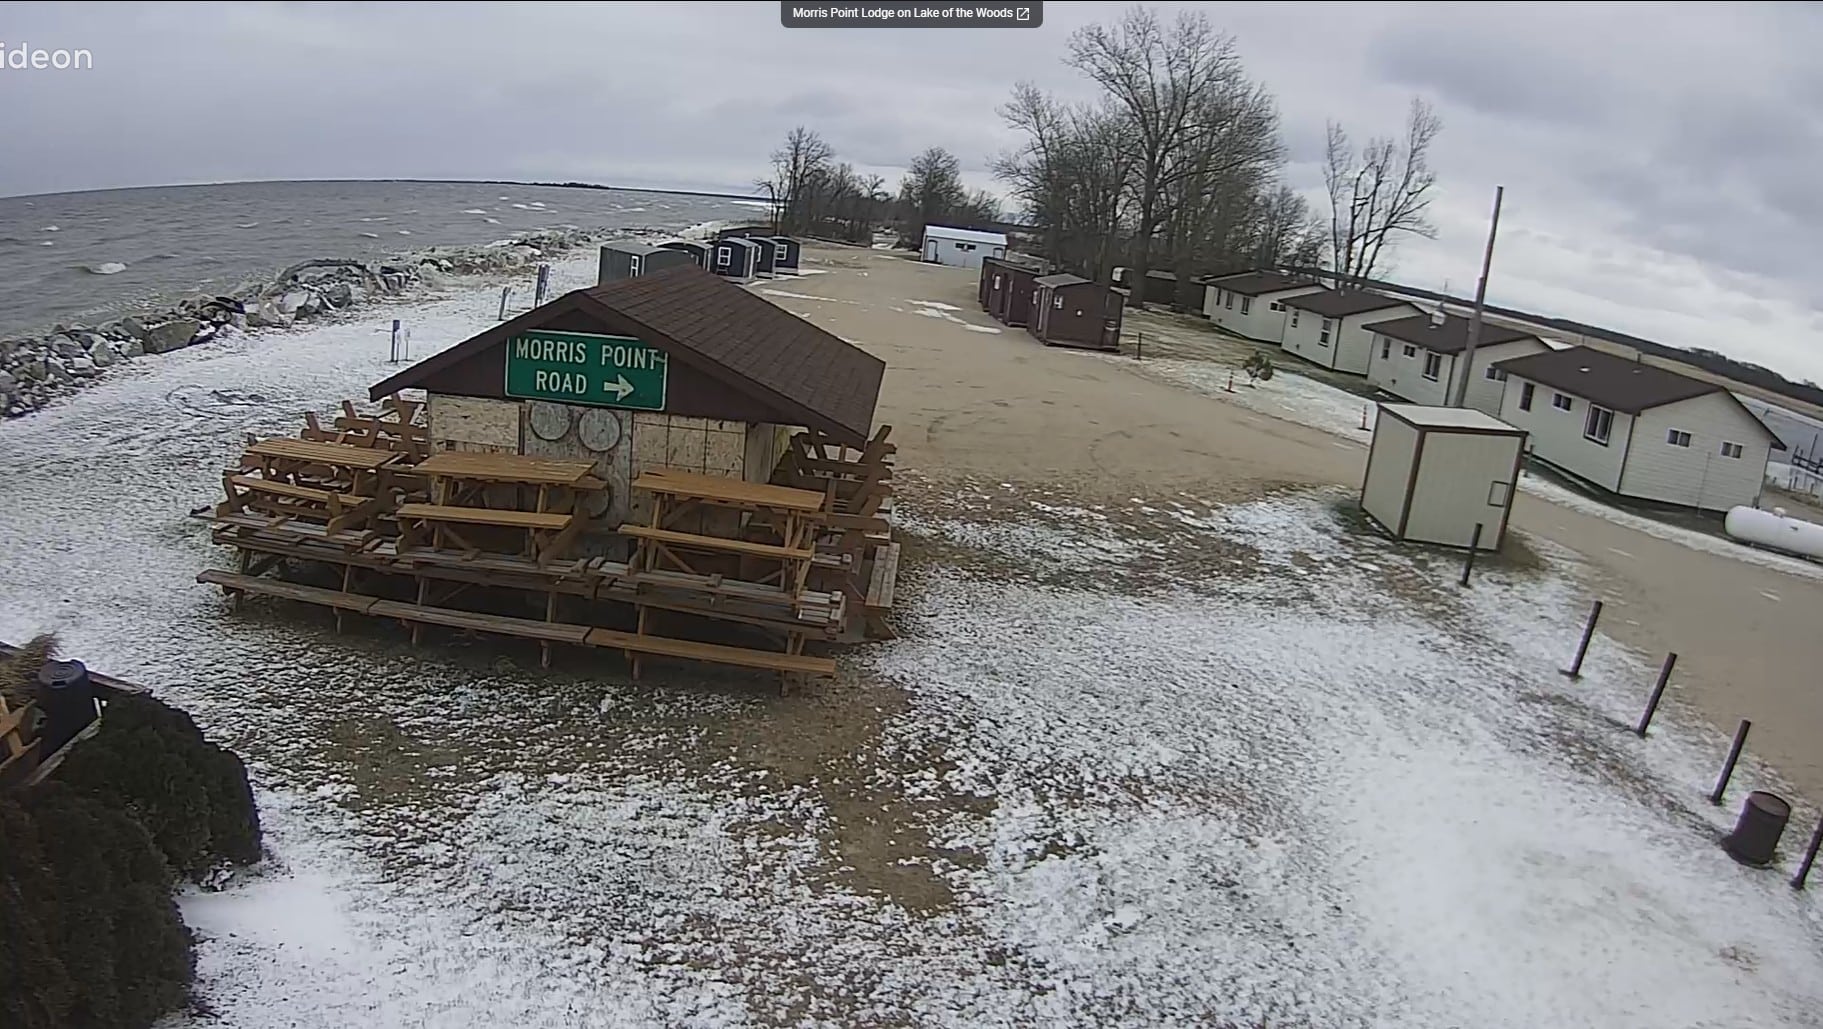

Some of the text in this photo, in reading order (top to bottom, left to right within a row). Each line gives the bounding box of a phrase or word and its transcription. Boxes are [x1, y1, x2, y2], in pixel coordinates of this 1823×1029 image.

[515, 338, 659, 370] MORRIS POINT
[536, 370, 587, 394] ROAD
